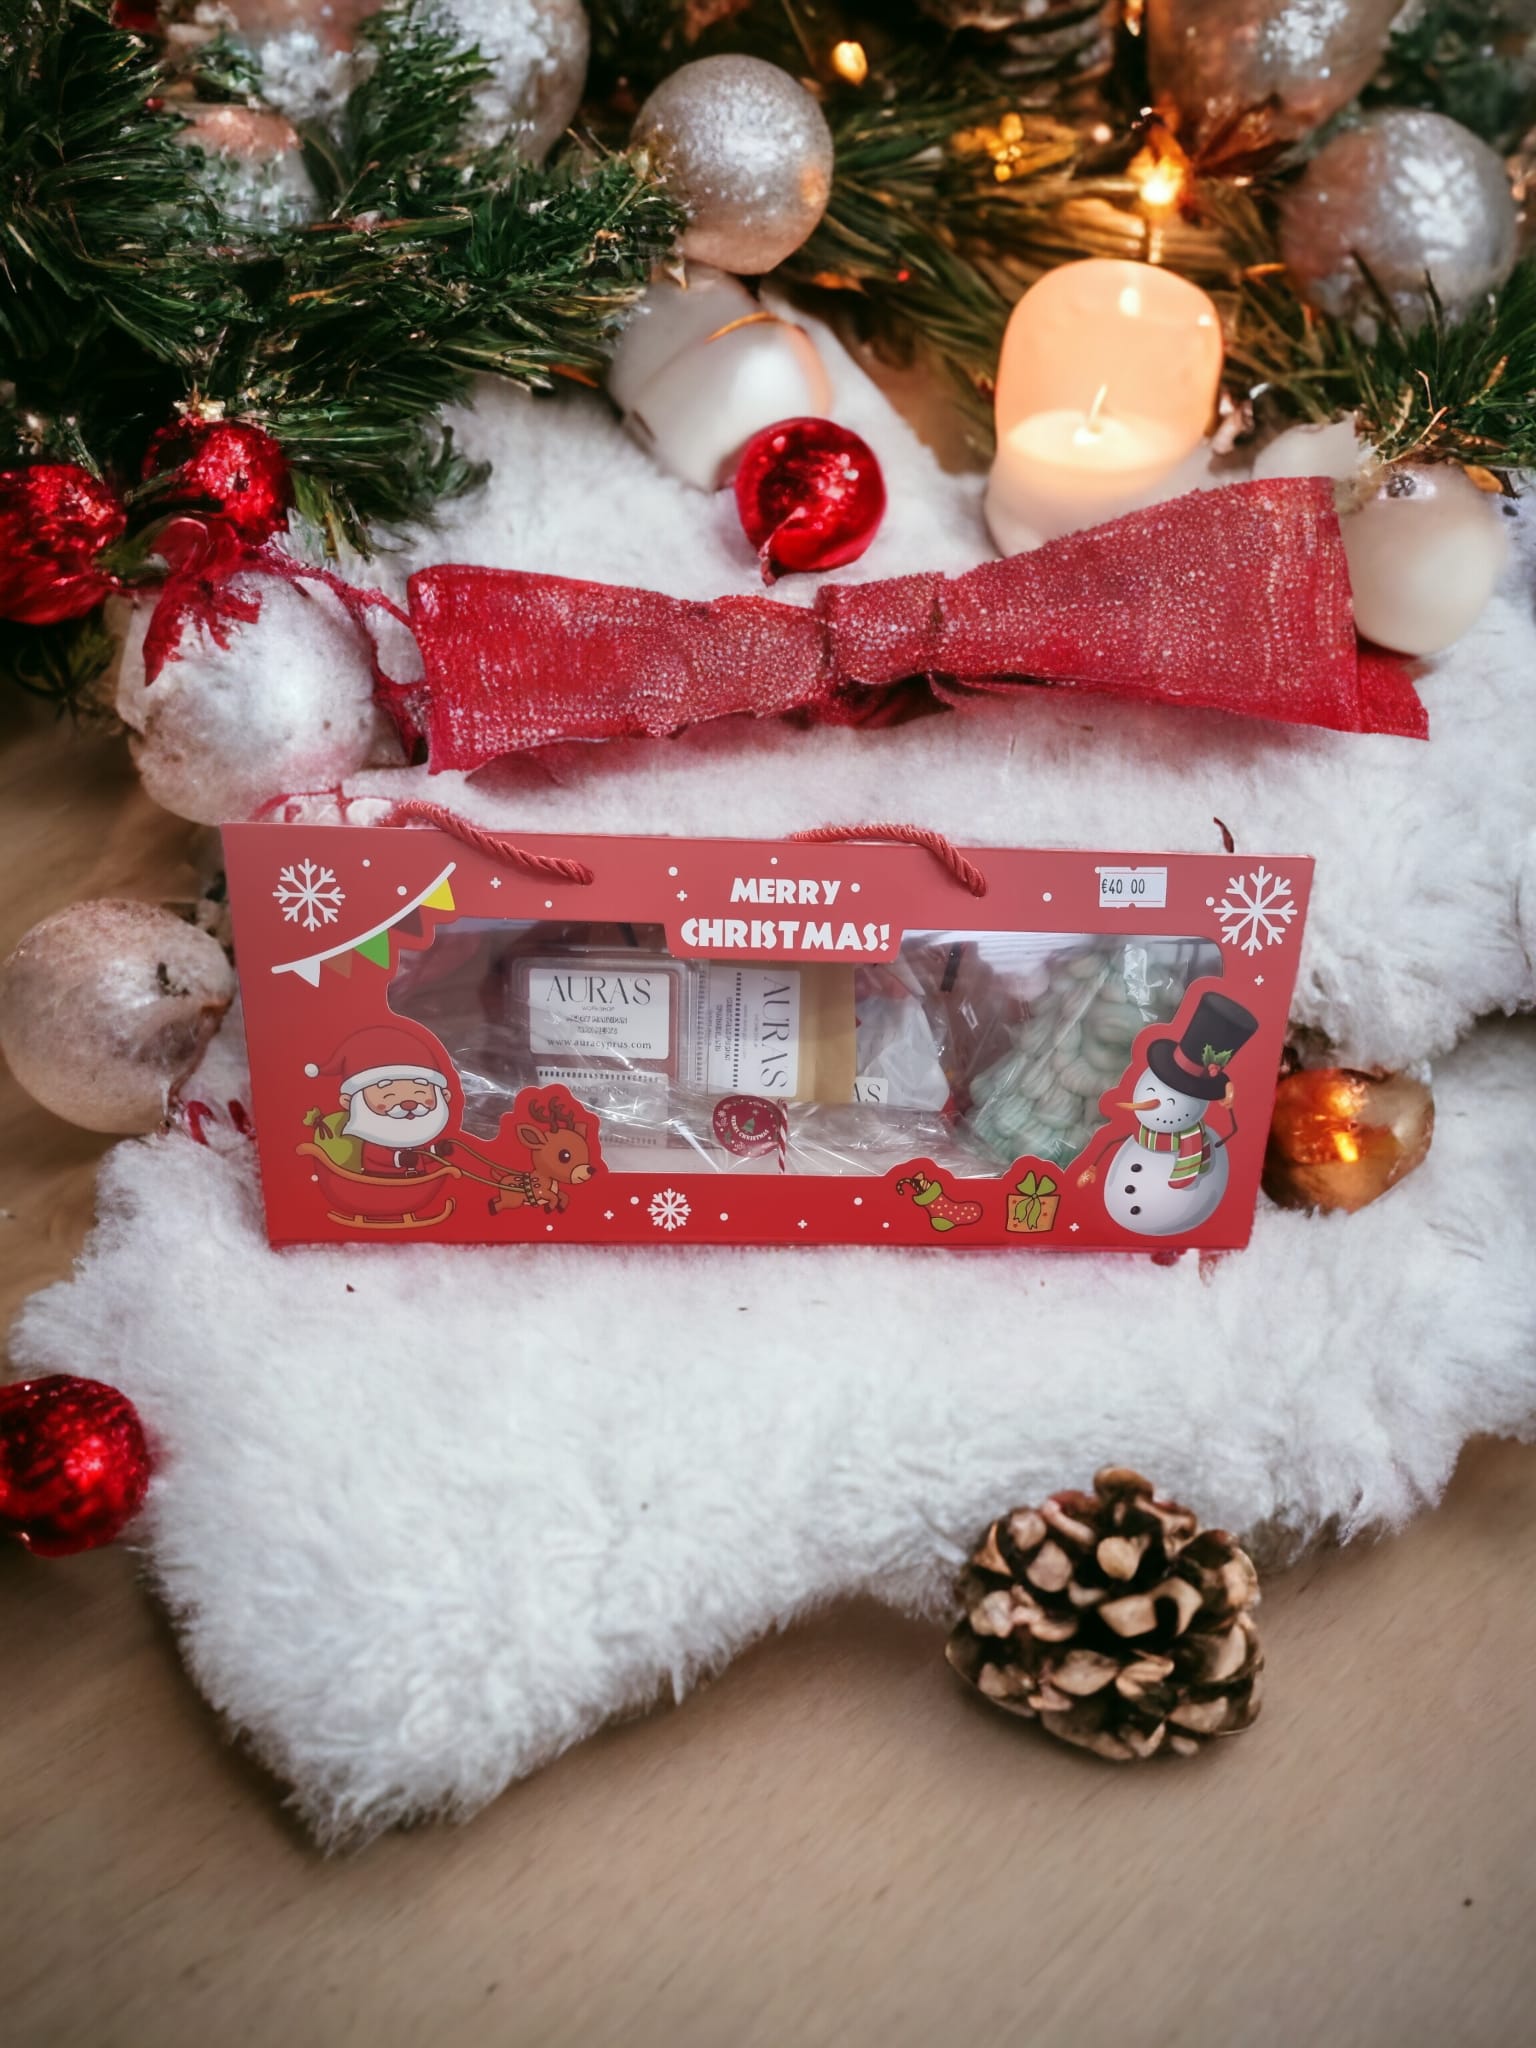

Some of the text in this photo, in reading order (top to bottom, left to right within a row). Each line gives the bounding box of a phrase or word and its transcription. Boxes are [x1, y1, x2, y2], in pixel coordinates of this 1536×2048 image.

[730, 878, 841, 904] MERRY
[680, 918, 890, 951] CHRISTMAS!
[547, 975, 651, 1006] AURA'S
[546, 1038, 652, 1050] www.auracyprus.com
